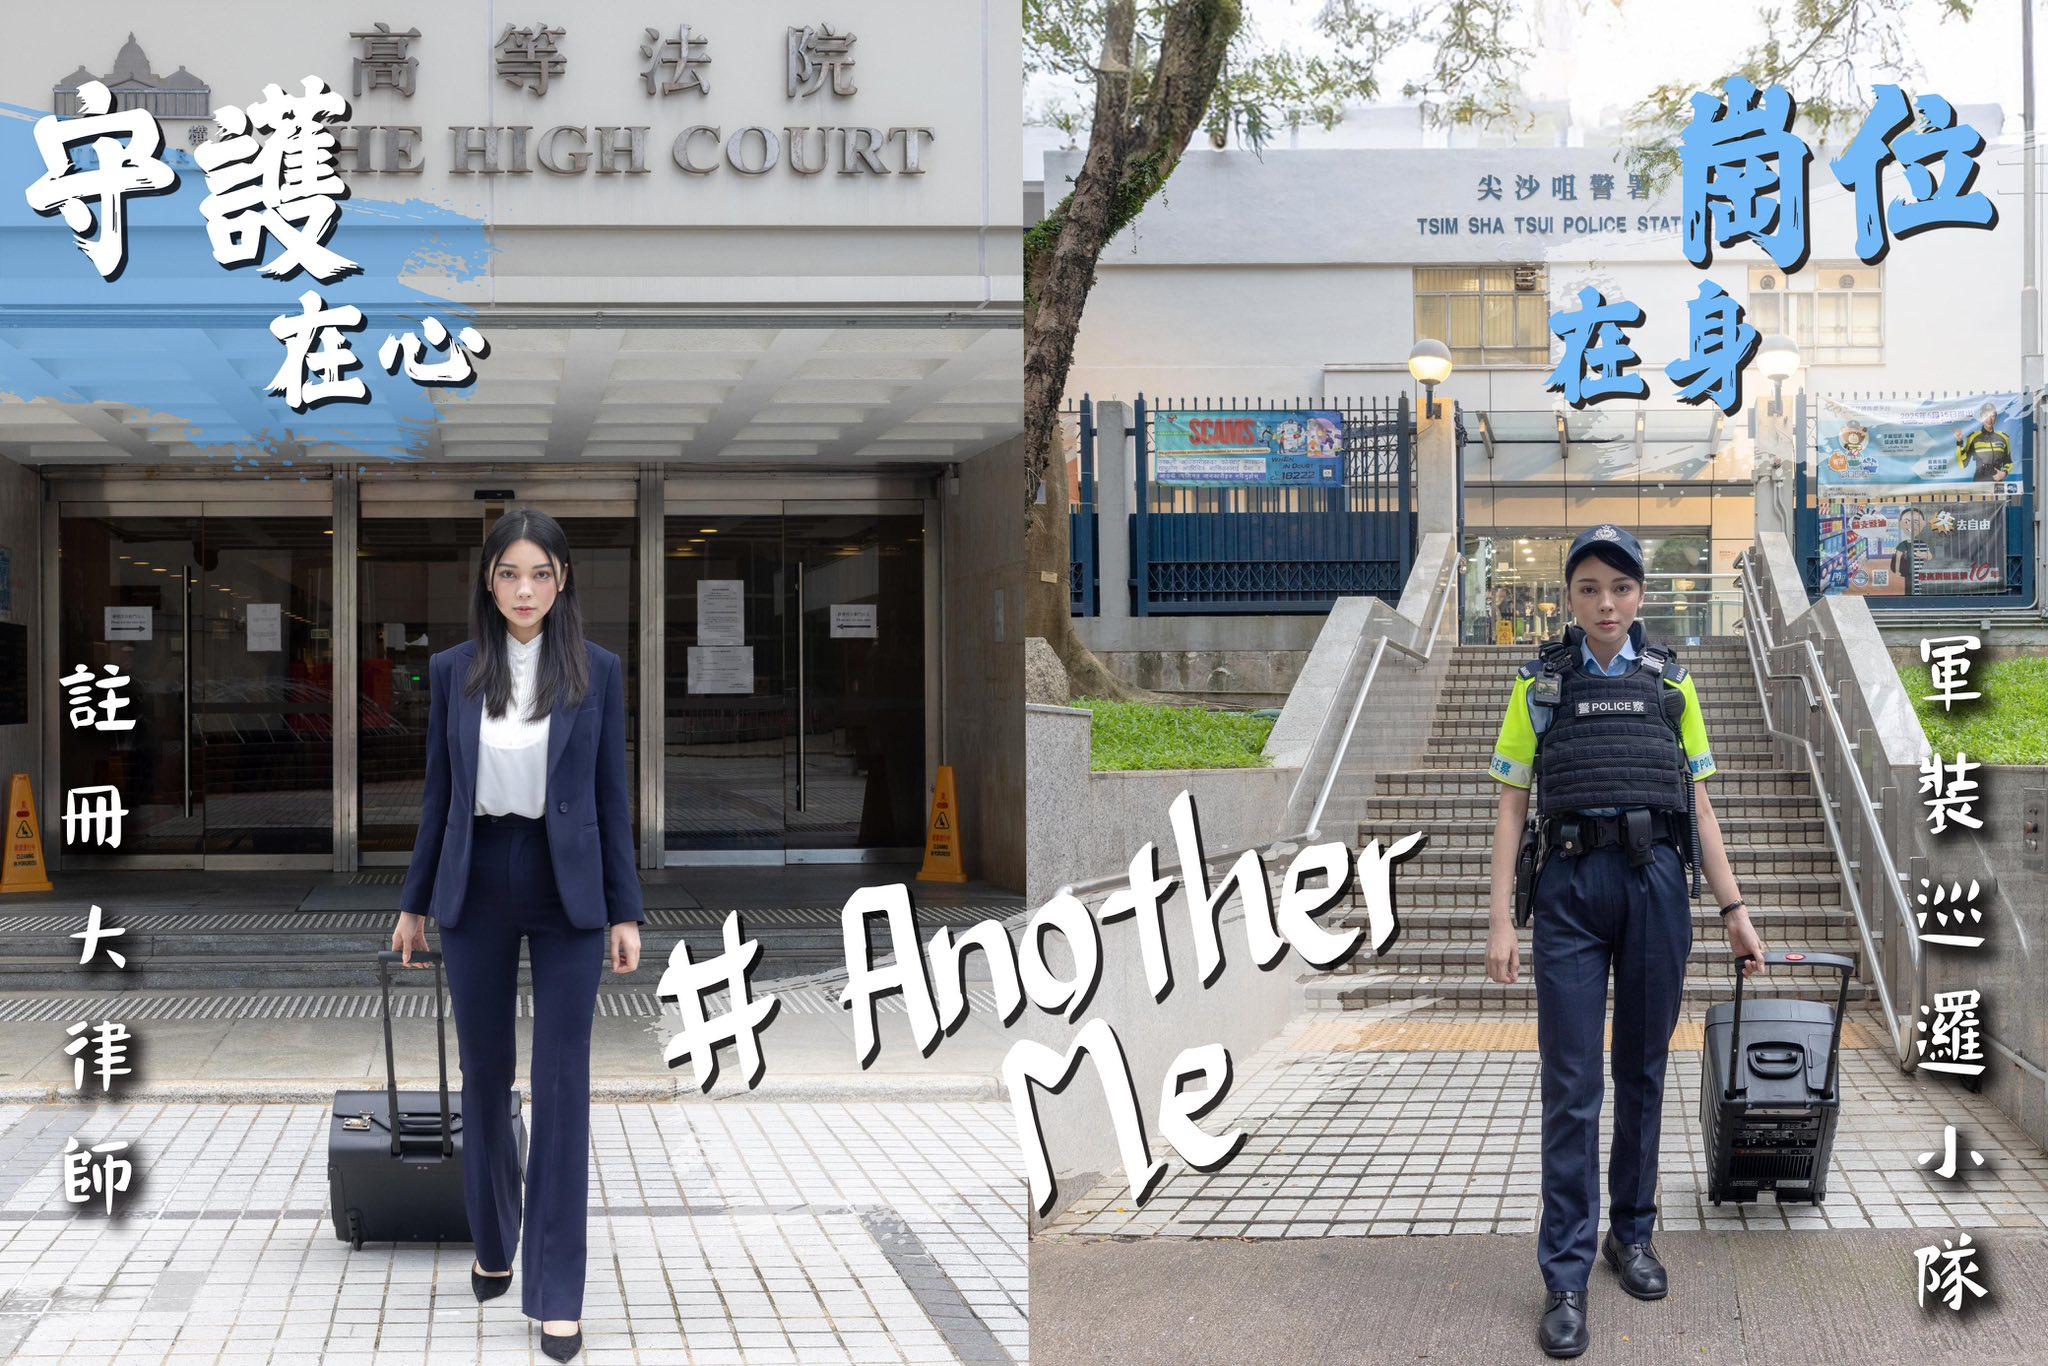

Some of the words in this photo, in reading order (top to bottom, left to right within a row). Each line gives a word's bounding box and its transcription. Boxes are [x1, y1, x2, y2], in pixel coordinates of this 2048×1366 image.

[349, 22, 858, 98] 高等法院
[334, 126, 425, 175] HE
[449, 125, 653, 175] HIGH
[672, 124, 936, 176] COURT
[1477, 174, 1650, 200] 尖沙咀警署
[1417, 217, 1458, 235] TSIM
[1468, 216, 1504, 234] SHA
[1514, 216, 1553, 234] TSUI
[1563, 216, 1627, 234] POLICE
[1637, 215, 1682, 234] STAT
[1188, 418, 1257, 446] SCAMS
[1592, 702, 1631, 712] POLICE
